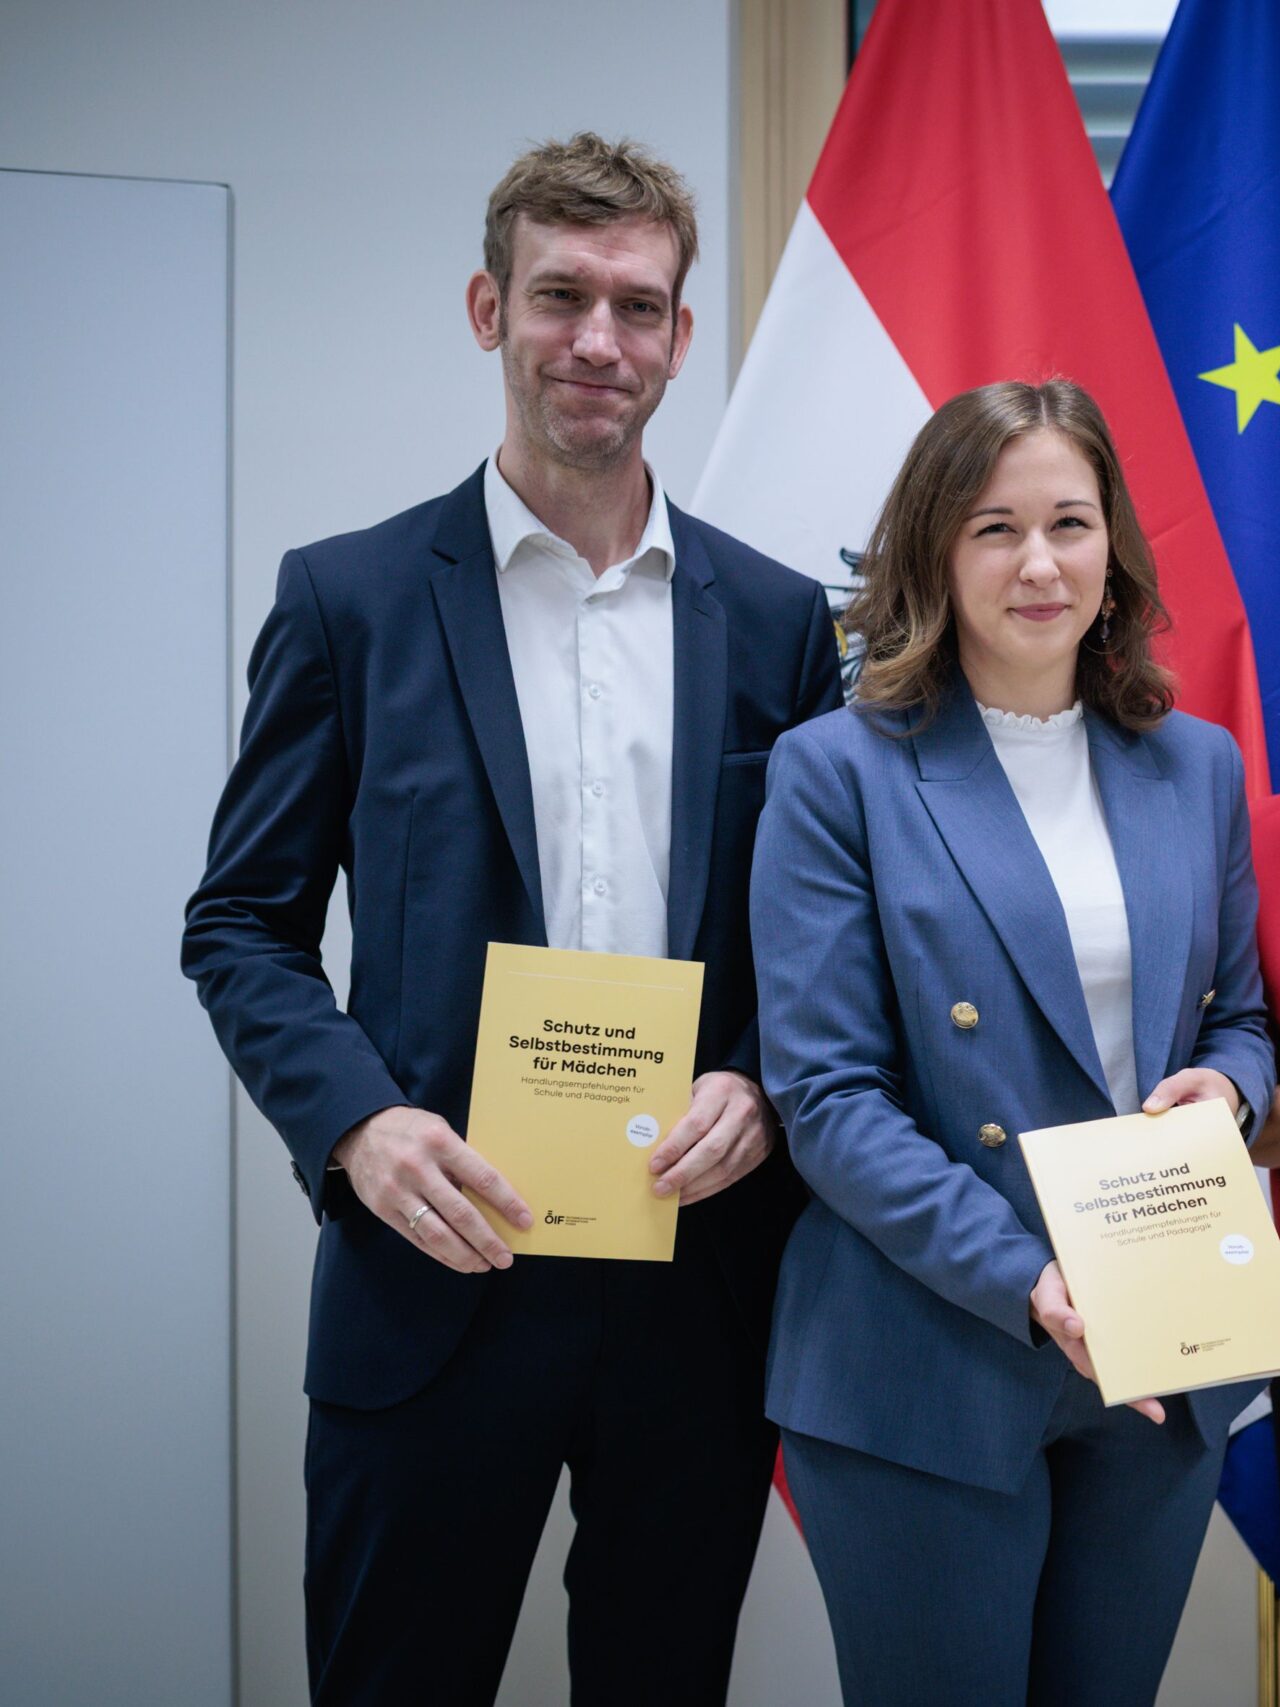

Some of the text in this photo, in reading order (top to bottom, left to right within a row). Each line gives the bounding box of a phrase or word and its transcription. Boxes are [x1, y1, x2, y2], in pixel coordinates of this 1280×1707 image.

[543, 1019, 636, 1040] Schutz und
[509, 1035, 664, 1064] Selbstbestimmung
[533, 1057, 637, 1078] für Mädchen
[521, 1076, 645, 1094] Handlungsempfehlungen für
[534, 1088, 563, 1098] Schule
[1098, 1162, 1190, 1191] Schutz und
[1074, 1175, 1226, 1214] Selbstbestimmung
[1104, 1196, 1208, 1224] für Mädchen
[1100, 1210, 1222, 1240] Handlungsempfehlungen für
[1117, 1234, 1146, 1247] Schule
[1148, 1230, 1165, 1240] und
